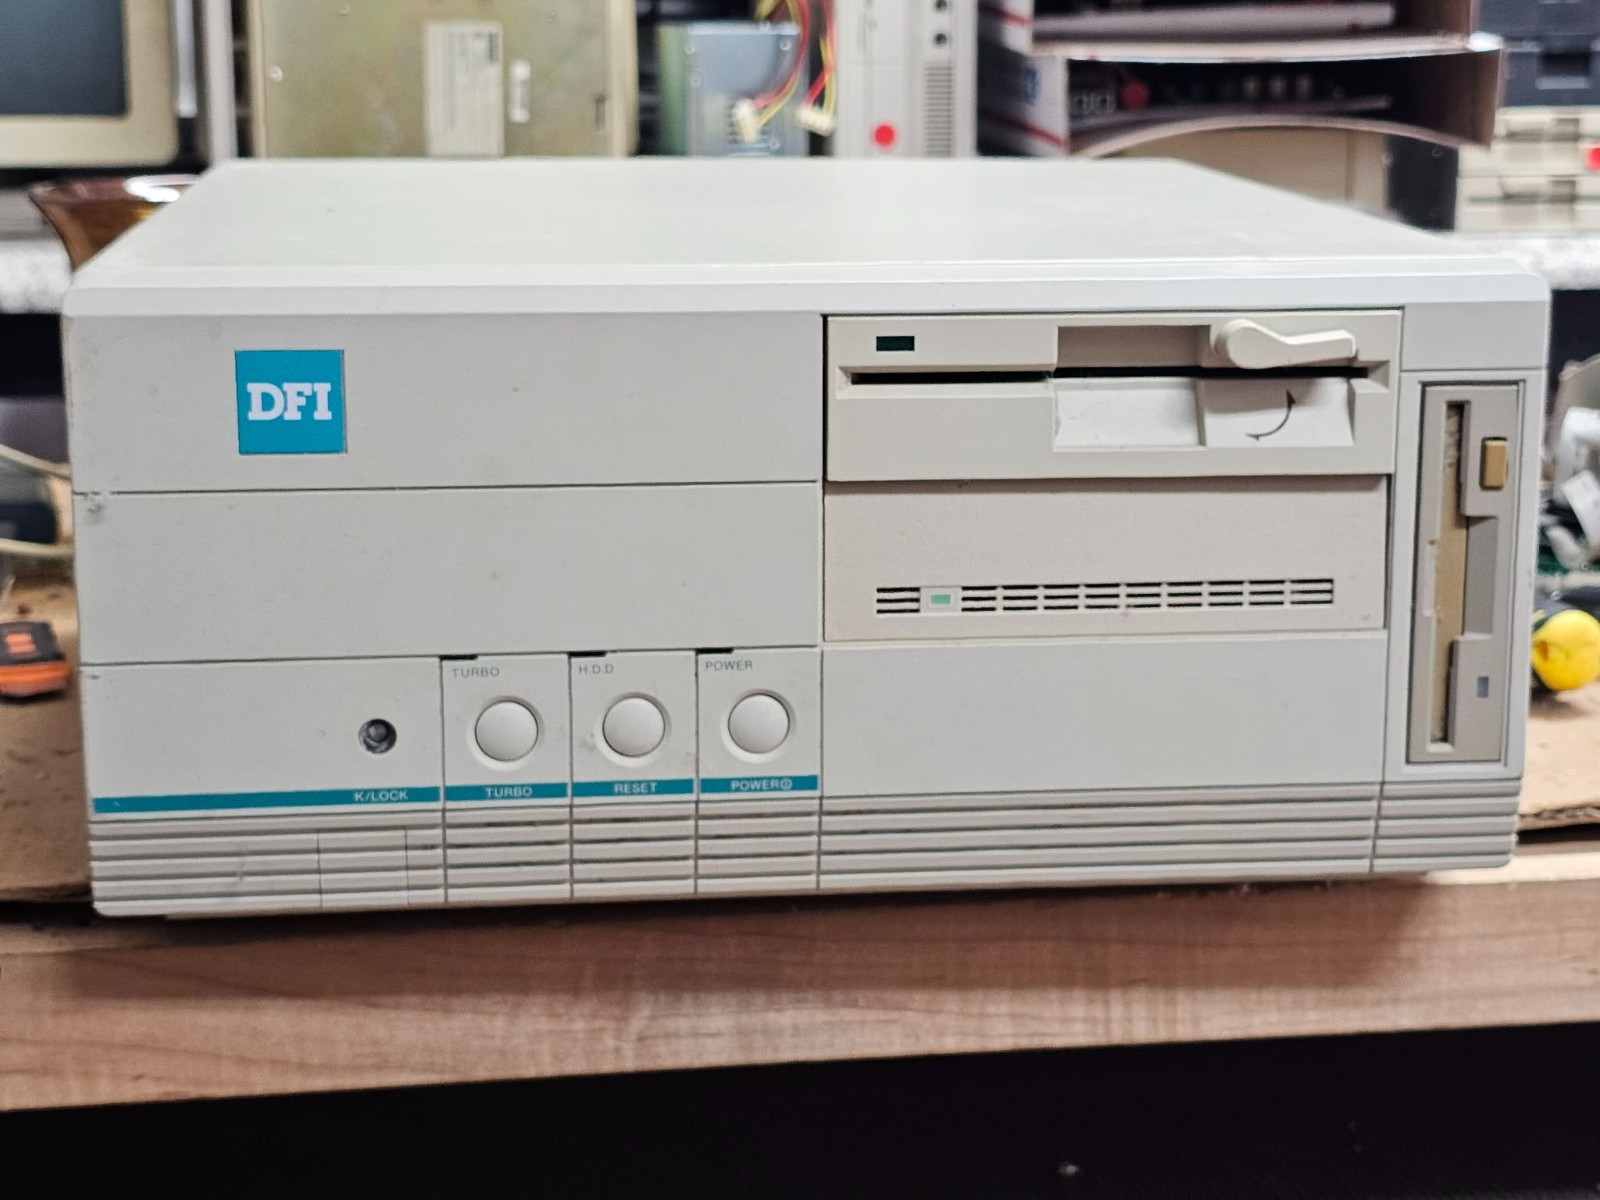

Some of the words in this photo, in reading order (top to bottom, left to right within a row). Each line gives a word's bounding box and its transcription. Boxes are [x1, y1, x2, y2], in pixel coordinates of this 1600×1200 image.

[246, 382, 333, 421] DFI
[705, 659, 753, 671] POWER
[452, 666, 500, 679] TURBO
[485, 786, 533, 799] TURBO
[613, 782, 658, 795] RESET
[354, 789, 409, 802] K/LOCK
